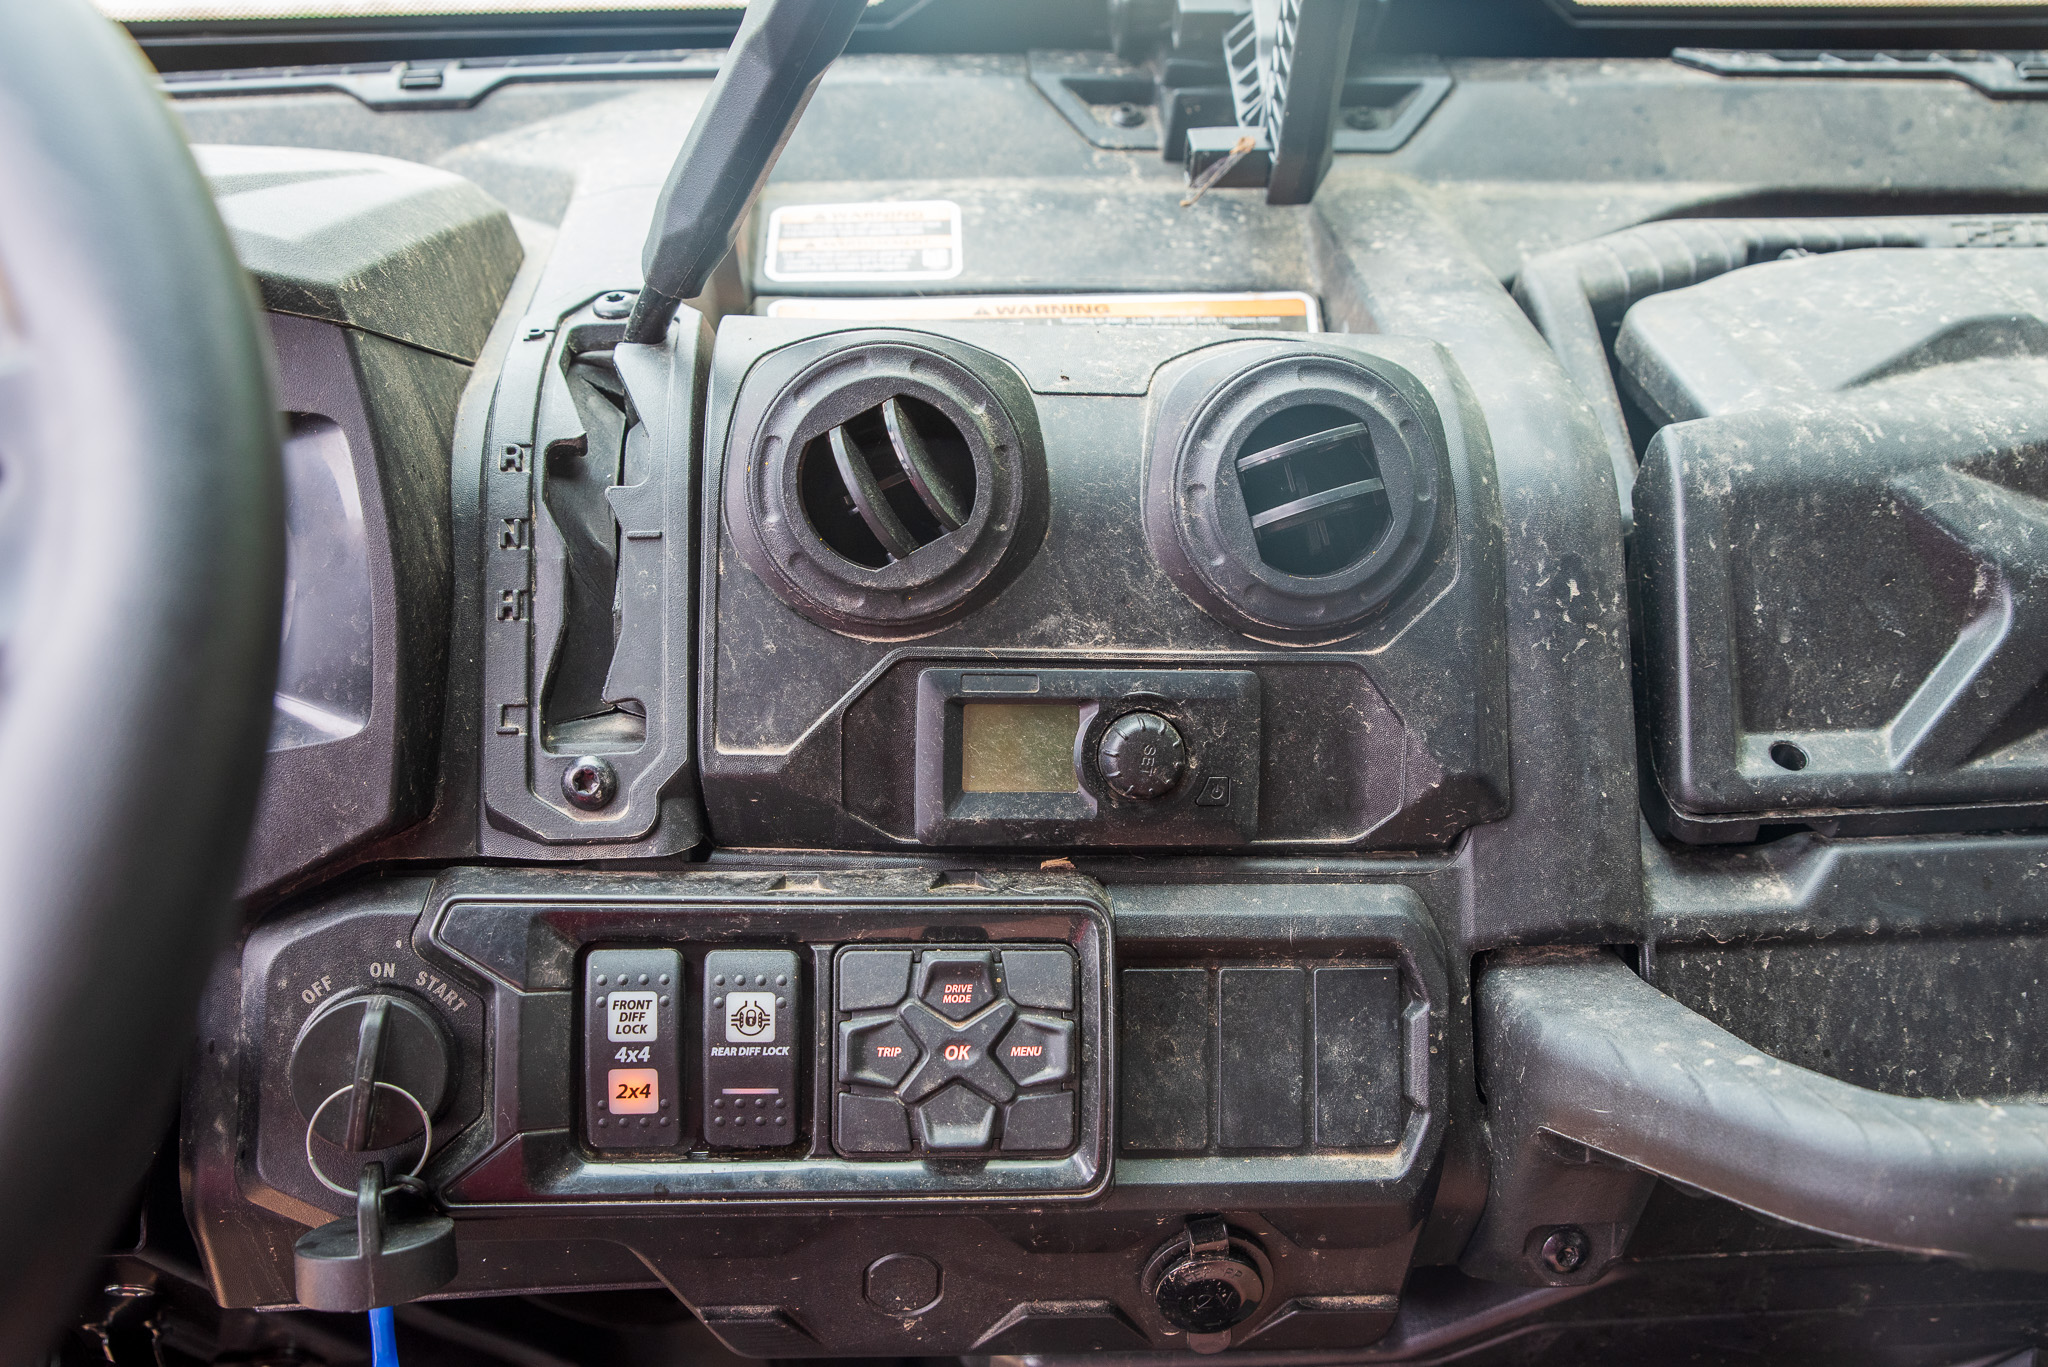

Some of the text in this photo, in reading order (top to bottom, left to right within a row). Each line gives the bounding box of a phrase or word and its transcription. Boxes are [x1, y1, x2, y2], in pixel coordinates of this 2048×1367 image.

[995, 303, 1111, 315] WARNING
[500, 443, 524, 472] R
[499, 518, 521, 549] N
[497, 589, 520, 621] H
[496, 703, 520, 735] L
[1140, 744, 1157, 777] SET
[369, 962, 396, 979] ON
[301, 975, 333, 1004] OFF
[415, 970, 468, 1013] START
[944, 984, 973, 993] DRIVE
[612, 999, 653, 1011] FRONT
[942, 994, 972, 1004] MODE
[619, 1011, 646, 1022] DIFF
[615, 1024, 648, 1035] LOCK
[614, 1046, 651, 1063] 4x4
[710, 1046, 790, 1057] REAR DIFF LOCK
[877, 1047, 902, 1058] TRIP
[944, 1045, 971, 1061] OK
[1010, 1046, 1043, 1057] MENU
[615, 1083, 652, 1099] 2x4
[1188, 1291, 1234, 1312] 12V
